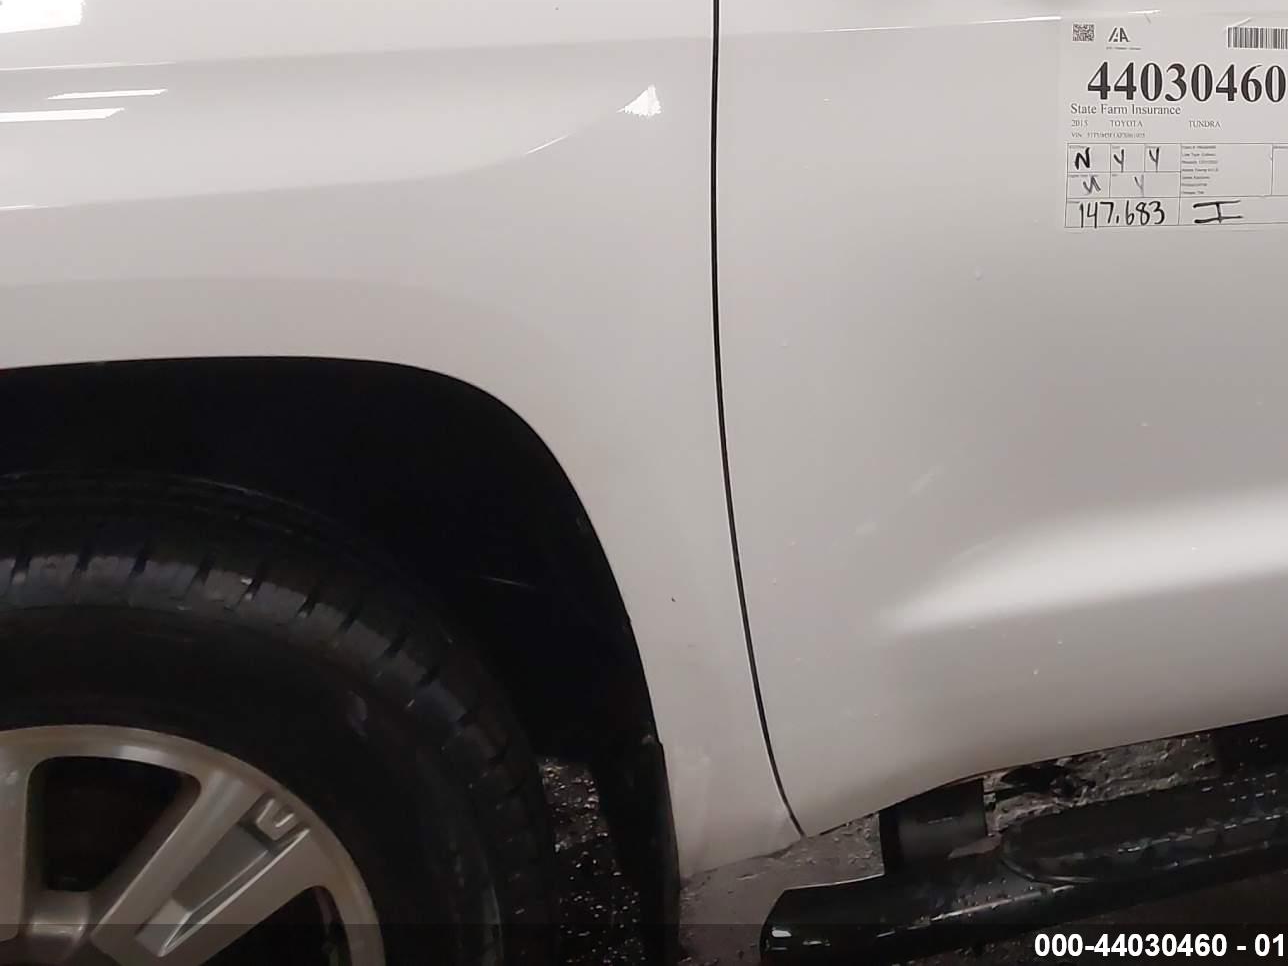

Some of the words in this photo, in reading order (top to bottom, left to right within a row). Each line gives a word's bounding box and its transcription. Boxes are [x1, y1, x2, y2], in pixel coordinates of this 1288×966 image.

[1087, 61, 1287, 102] 44030460
[1070, 103, 1097, 115] State
[1100, 104, 1128, 115] Farm
[1131, 104, 1181, 115] Insurance
[1071, 120, 1089, 128] 2015
[1110, 120, 1143, 128] TOYOTA
[1188, 121, 1221, 129] TUNDRA
[1074, 147, 1091, 170] N
